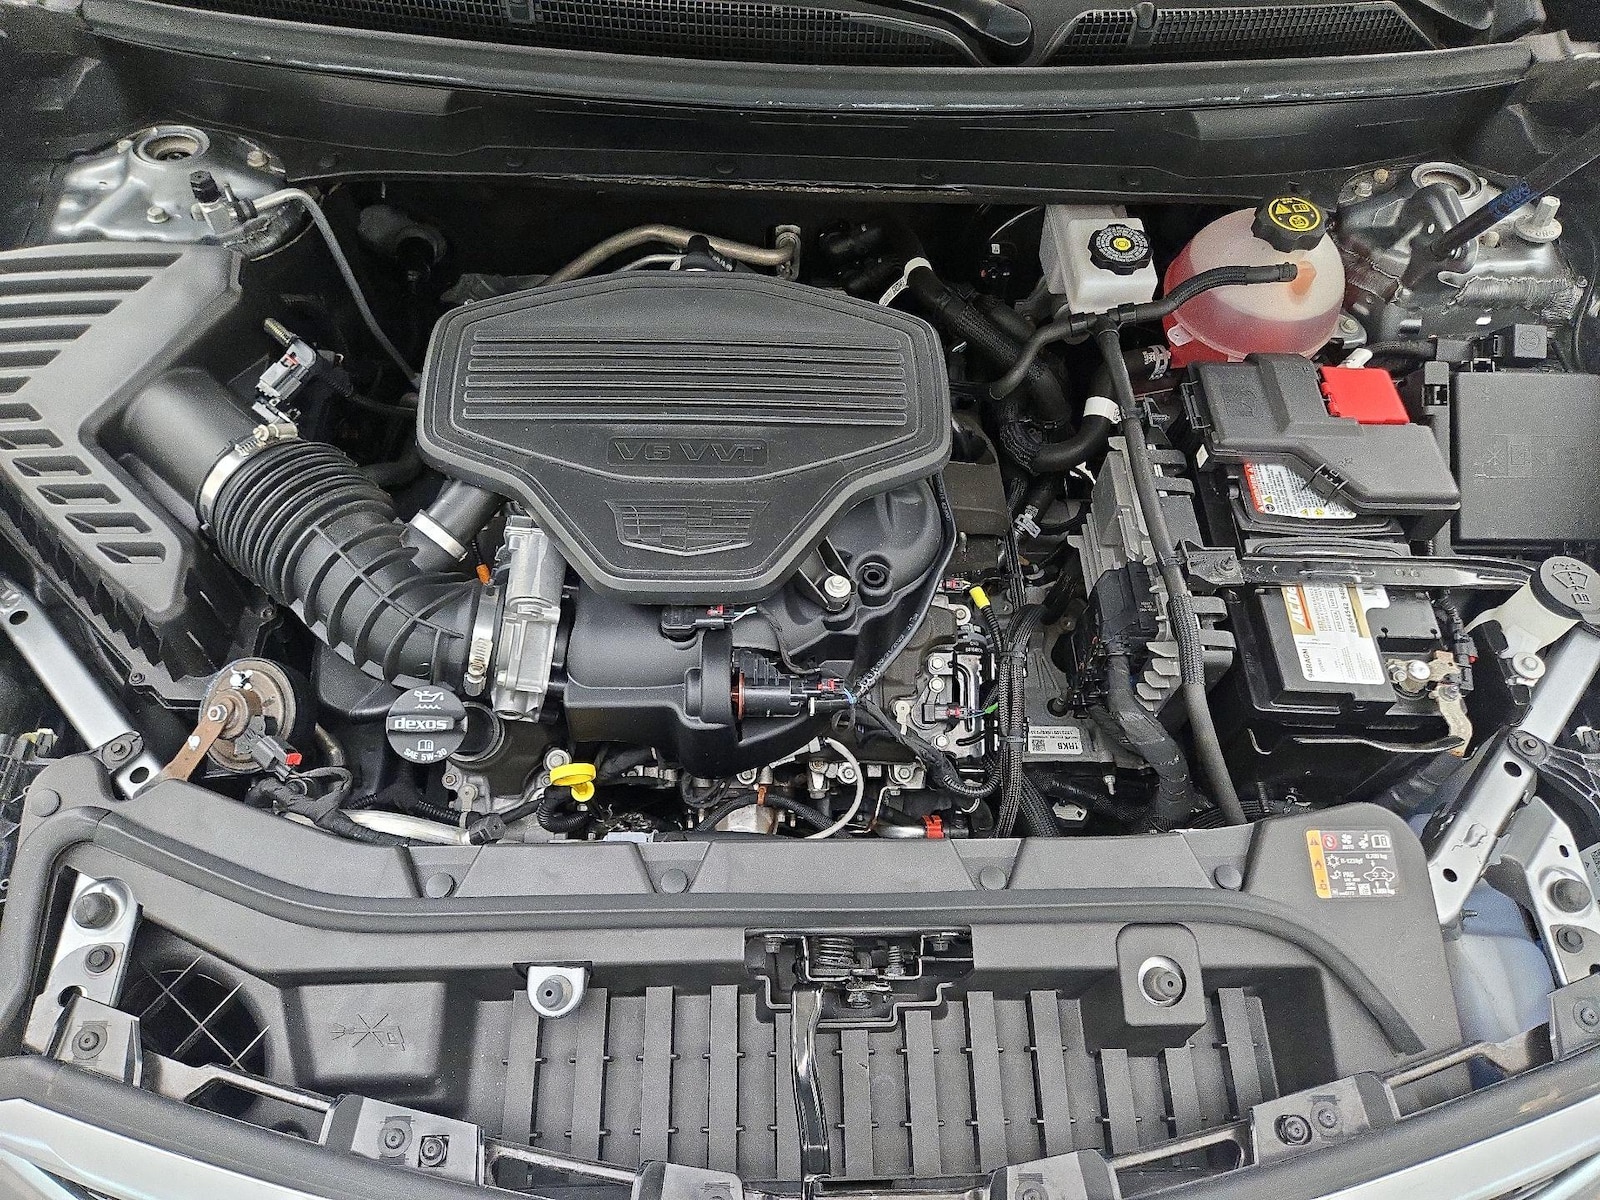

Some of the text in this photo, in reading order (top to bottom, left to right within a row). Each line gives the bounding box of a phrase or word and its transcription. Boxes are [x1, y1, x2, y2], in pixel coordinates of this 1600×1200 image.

[614, 442, 765, 462] V6 VVT
[394, 717, 449, 730] dexos
[403, 748, 448, 761] SAE 5W-30
